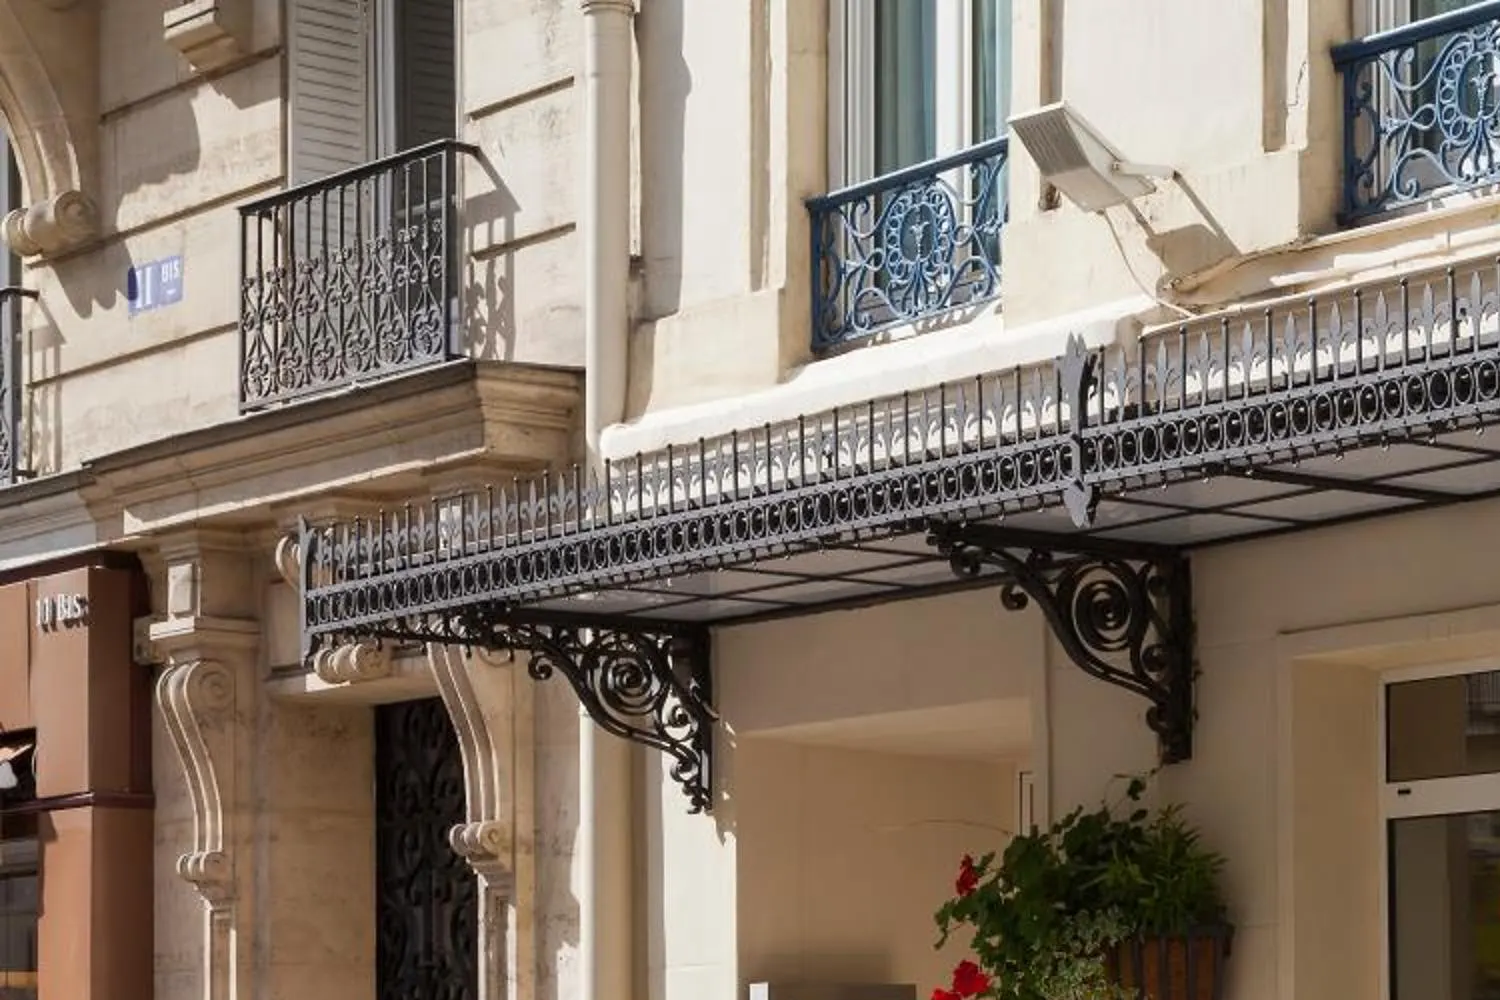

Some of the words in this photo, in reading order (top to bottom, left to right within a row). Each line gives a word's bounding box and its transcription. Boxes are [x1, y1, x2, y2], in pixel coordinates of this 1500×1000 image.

[135, 266, 152, 309] 11
[161, 259, 179, 283] BIS
[57, 593, 81, 620] BIS
